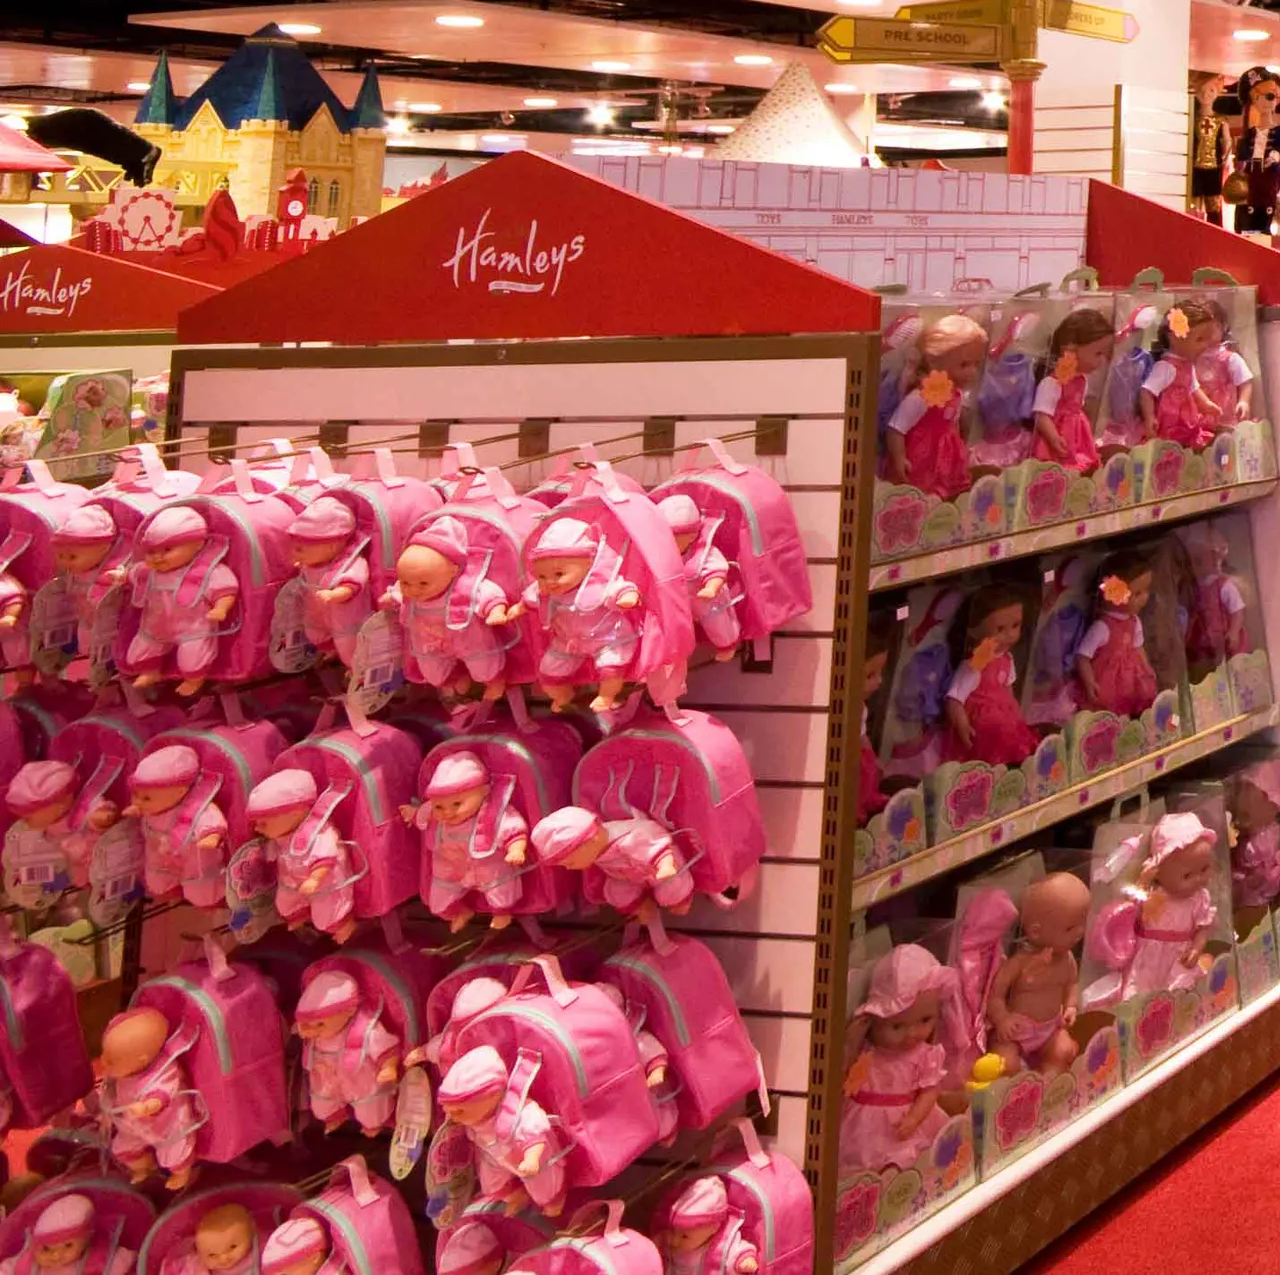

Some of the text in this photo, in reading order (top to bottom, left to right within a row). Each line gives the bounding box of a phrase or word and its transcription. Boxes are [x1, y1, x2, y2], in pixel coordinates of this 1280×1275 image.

[884, 29, 970, 44] PRE SCHOOL
[442, 207, 585, 297] Hamleys
[0, 259, 93, 317] Hamleys
